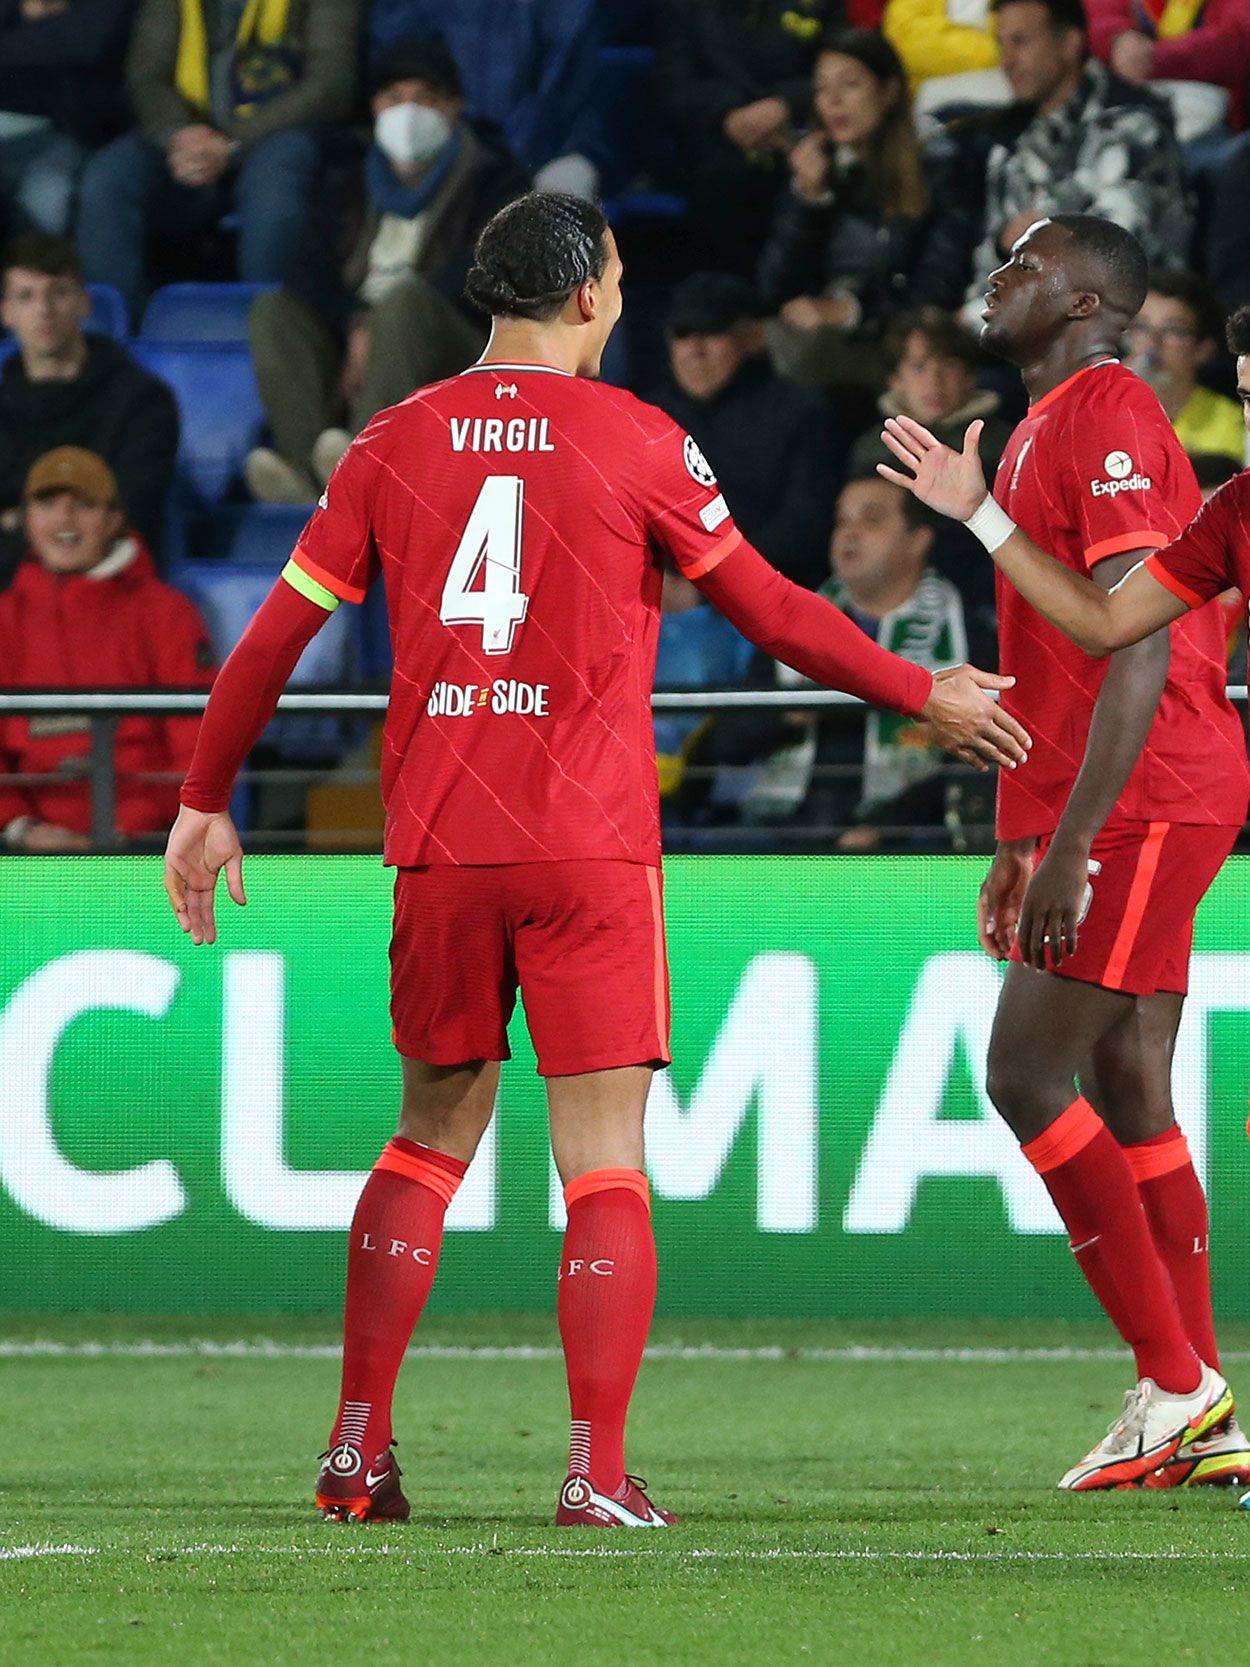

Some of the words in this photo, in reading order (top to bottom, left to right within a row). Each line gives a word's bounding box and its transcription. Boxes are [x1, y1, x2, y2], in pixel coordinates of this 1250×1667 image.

[449, 417, 556, 452] VIRGIL
[1090, 473, 1151, 497] Expedia
[439, 475, 530, 655] 4
[427, 681, 479, 717] SIDE
[491, 679, 550, 716] SIDE
